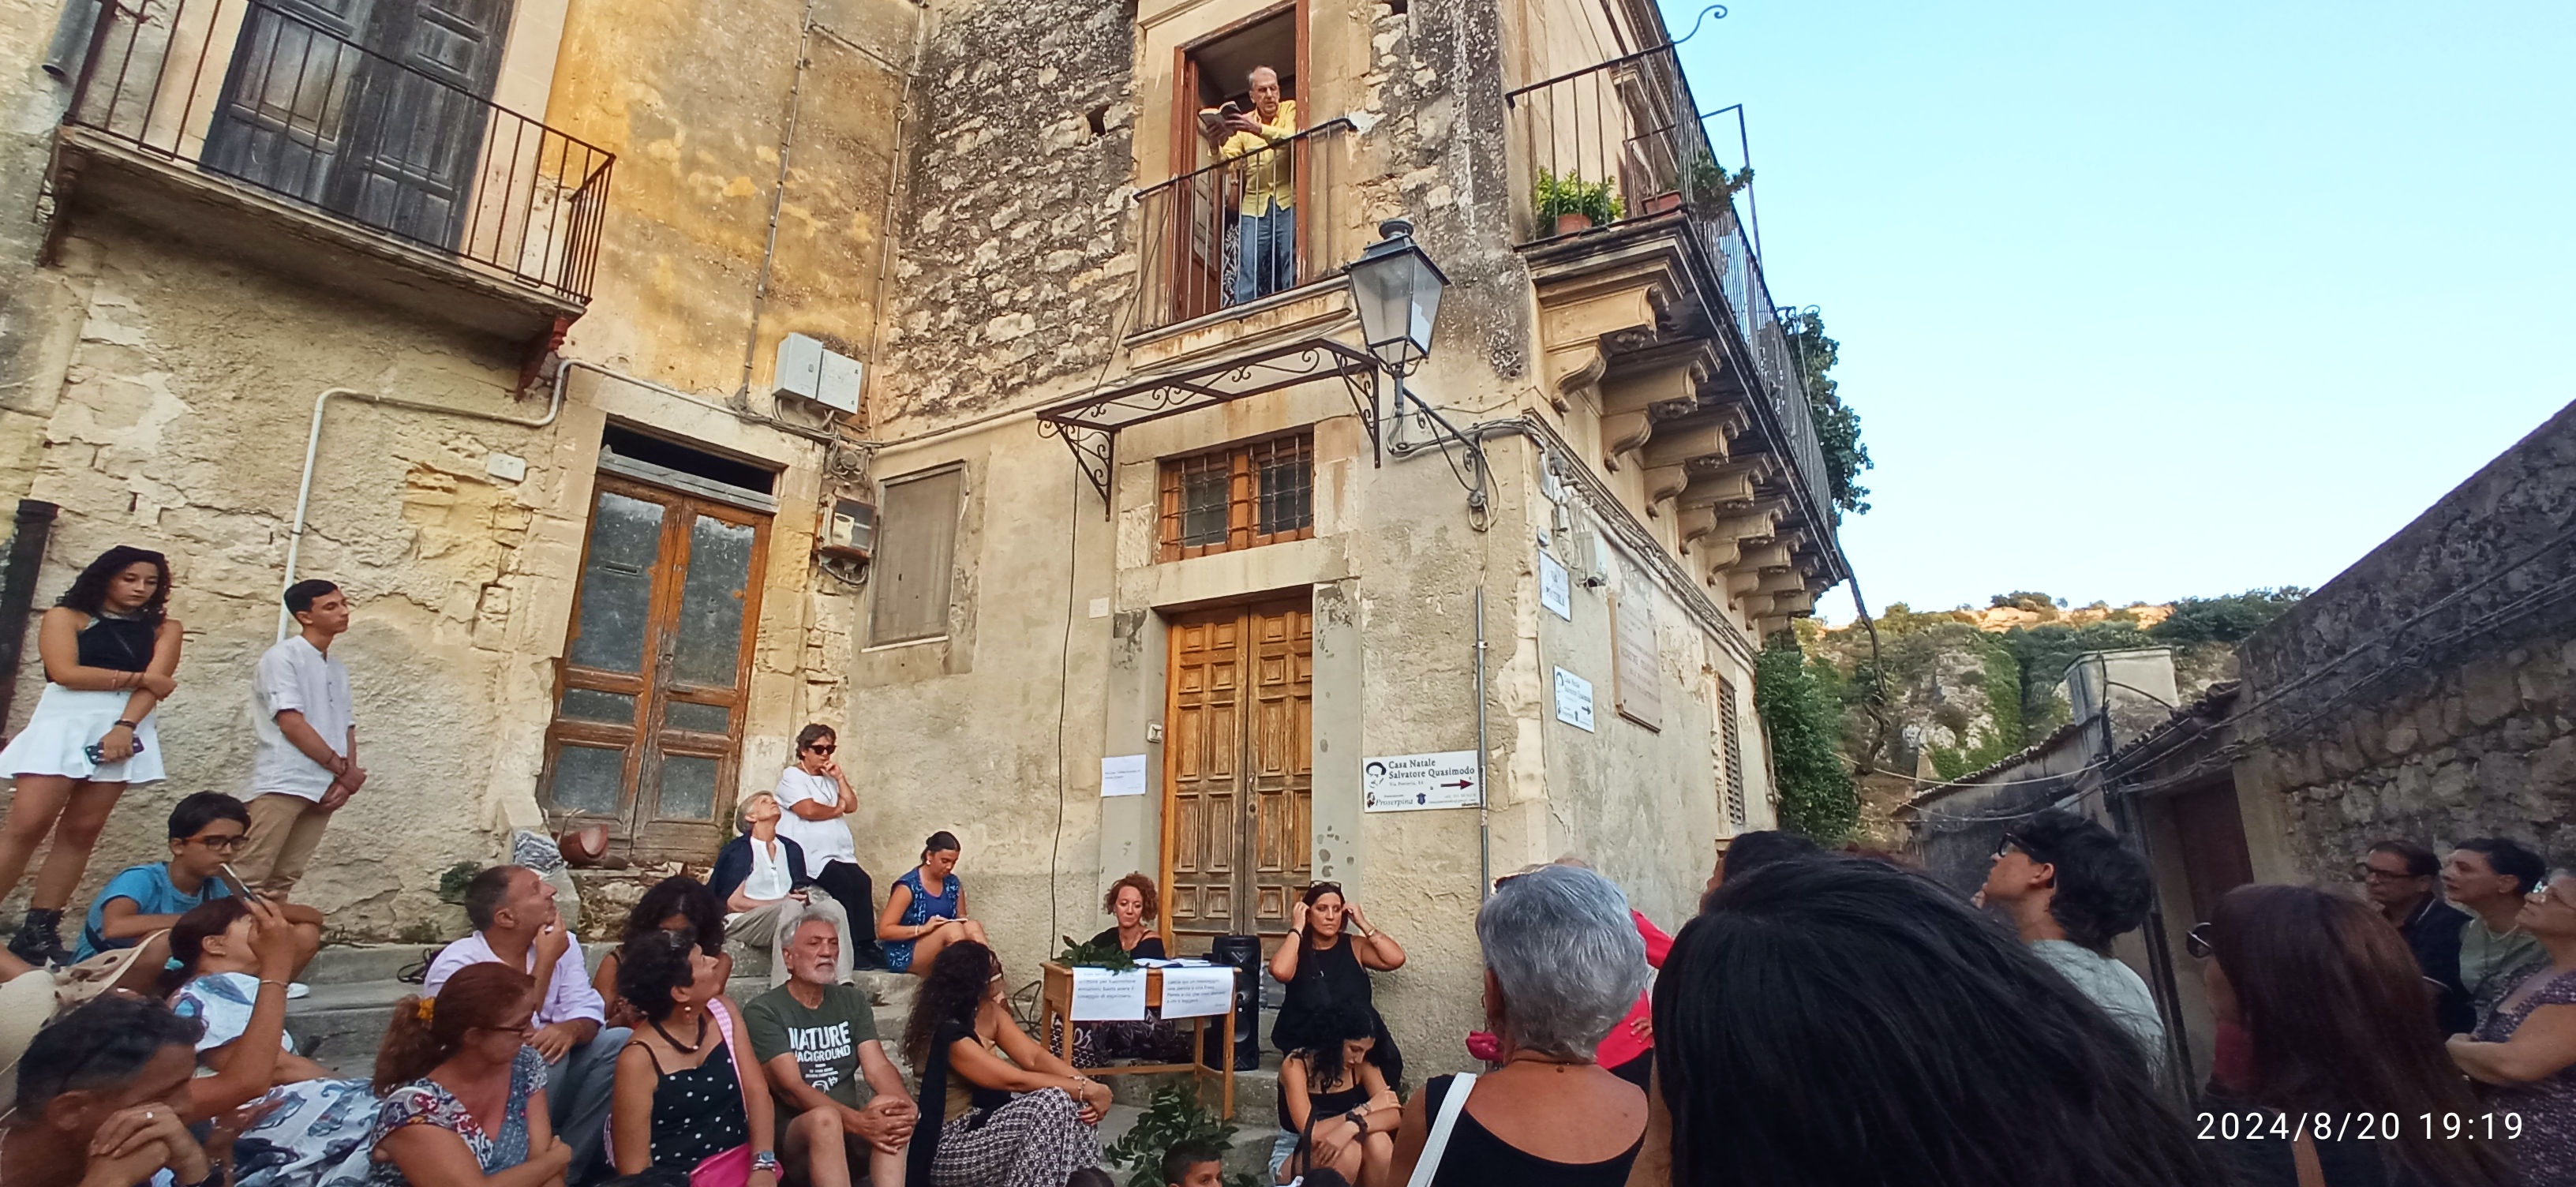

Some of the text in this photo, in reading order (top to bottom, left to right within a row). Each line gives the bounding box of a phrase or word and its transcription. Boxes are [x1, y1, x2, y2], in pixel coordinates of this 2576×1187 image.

[1388, 758, 1436, 769] Casa Natale
[1388, 766, 1475, 780] Salvatore Quasimodo
[1375, 797, 1413, 807] Proserpina
[788, 1020, 852, 1050] NATURE
[795, 1044, 852, 1062] ACGROUND
